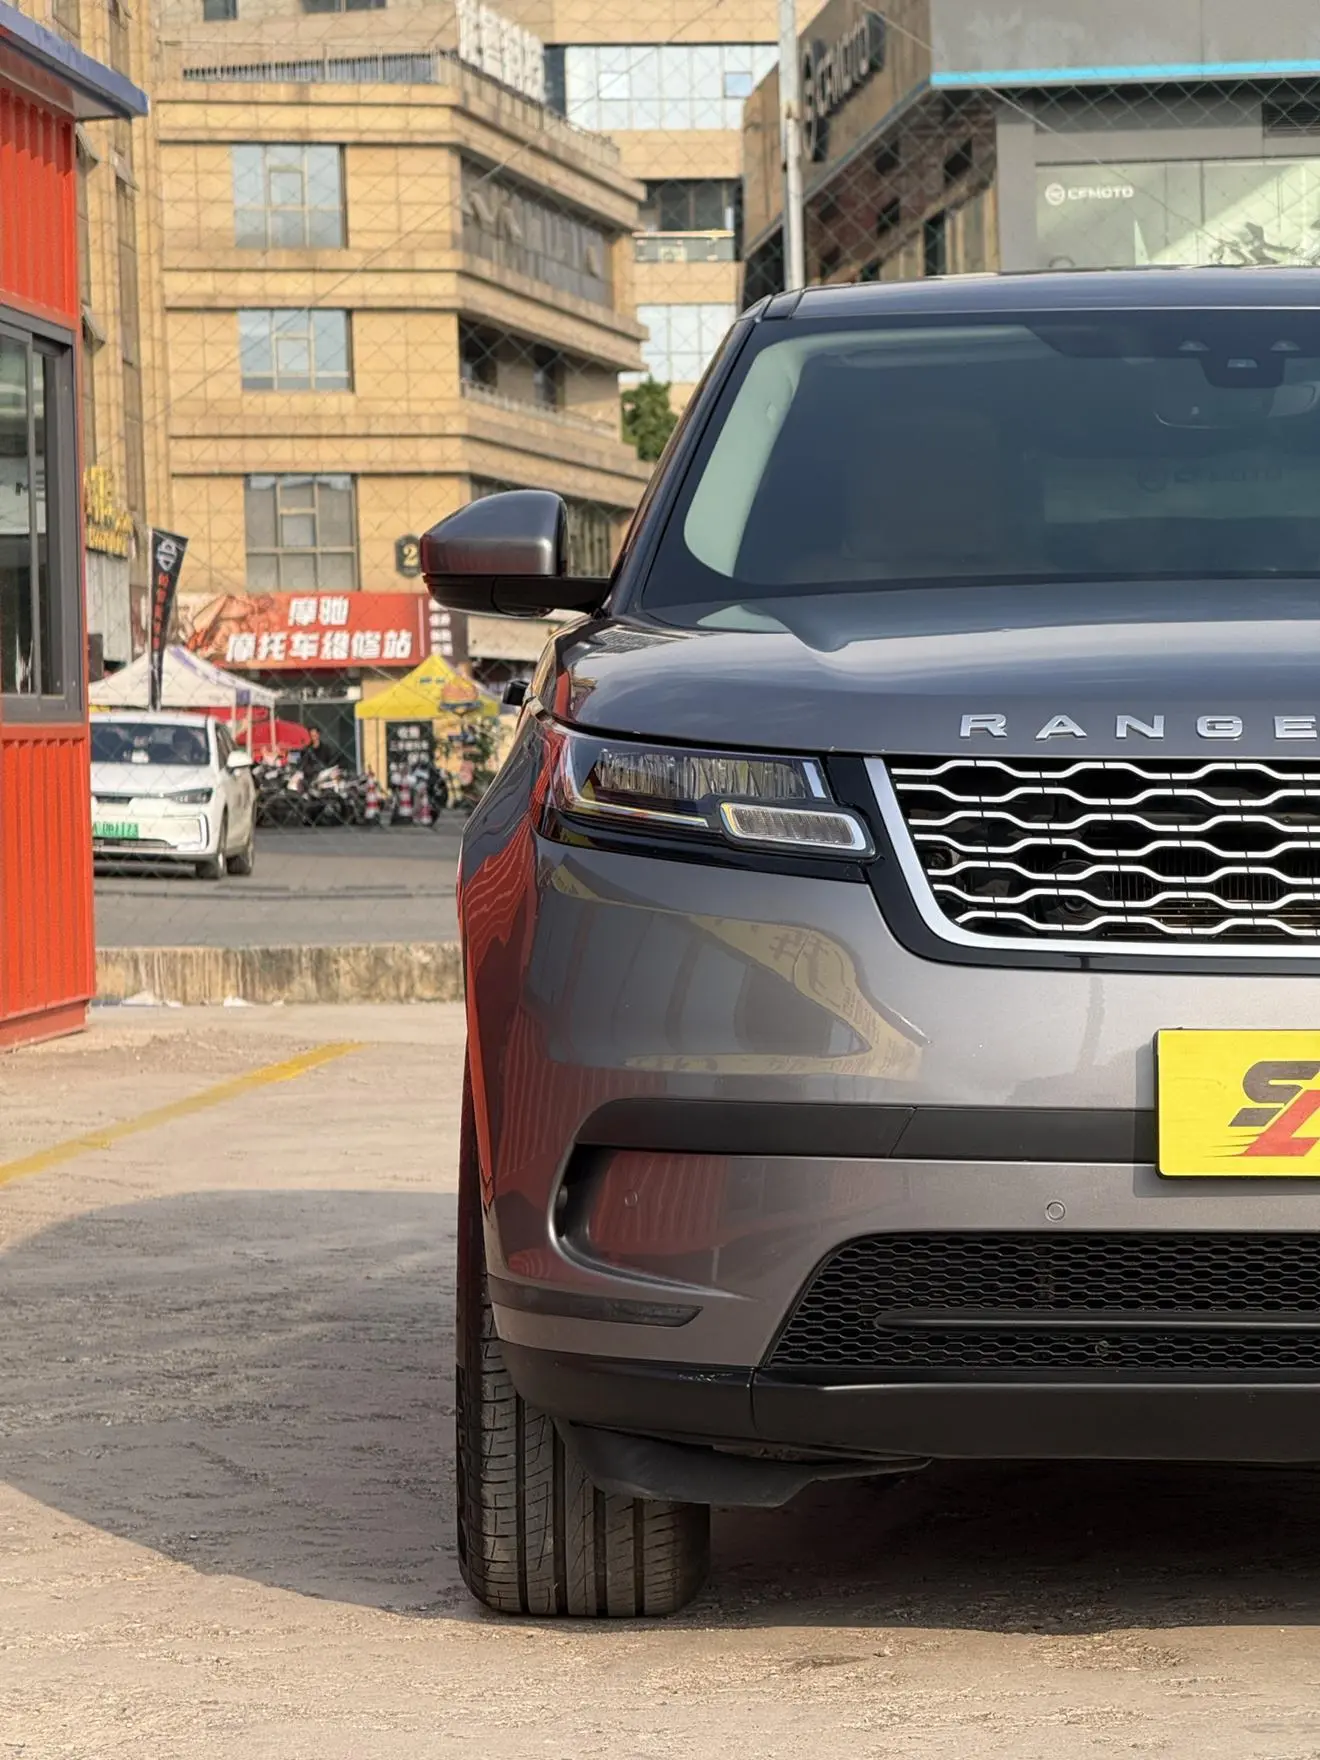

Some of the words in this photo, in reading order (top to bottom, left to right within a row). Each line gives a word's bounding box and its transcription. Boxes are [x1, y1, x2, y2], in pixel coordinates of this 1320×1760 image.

[1067, 185, 1134, 200] CFMOTO
[402, 543, 418, 567] 2
[226, 629, 412, 662] 摩托车维修站
[960, 714, 1317, 741] RANGE
